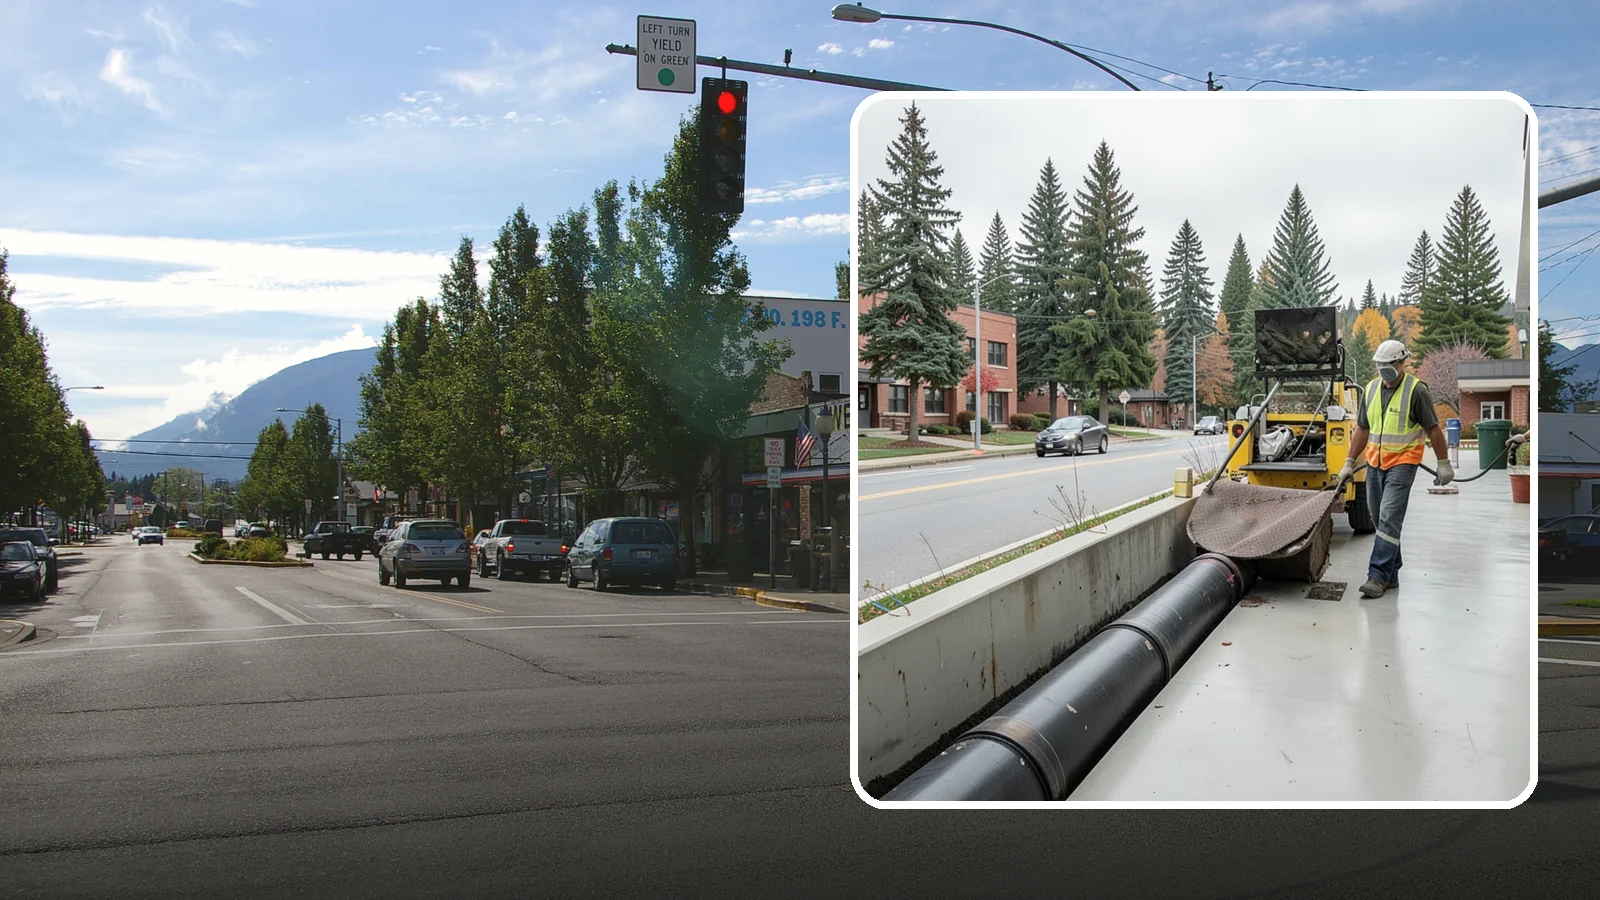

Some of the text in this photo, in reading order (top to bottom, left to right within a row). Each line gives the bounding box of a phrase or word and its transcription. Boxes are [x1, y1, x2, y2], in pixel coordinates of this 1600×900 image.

[643, 23, 690, 36] LEFT TURN
[652, 38, 682, 52] YIELD
[644, 53, 656, 64] ON
[791, 309, 826, 328] 198
[831, 311, 846, 329] F.
